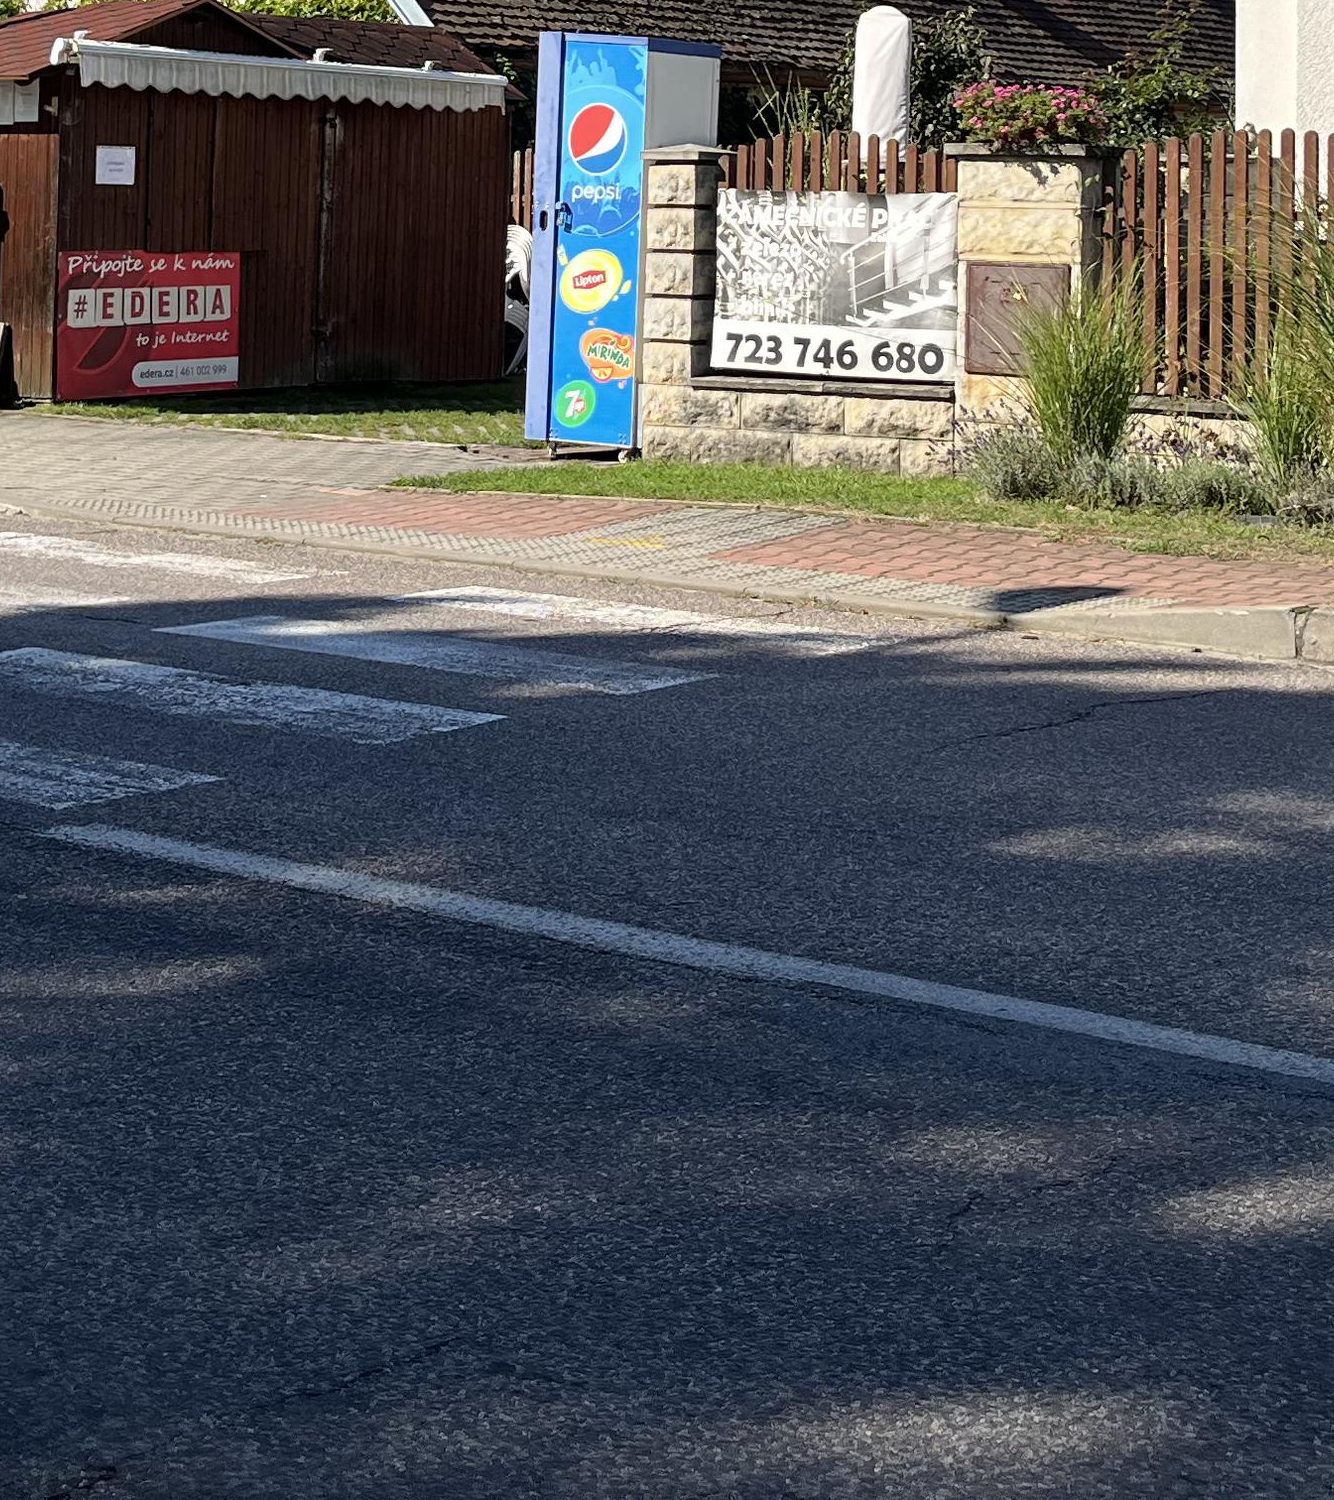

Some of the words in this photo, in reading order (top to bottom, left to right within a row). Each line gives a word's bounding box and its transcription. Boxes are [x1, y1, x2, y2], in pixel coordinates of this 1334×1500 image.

[572, 183, 621, 204] pepsi
[68, 254, 143, 277] Připojte
[148, 258, 167, 273] se
[173, 255, 186, 271] k
[192, 252, 234, 269] nám
[575, 273, 604, 287] Lipton
[74, 288, 225, 319] #EDERA
[136, 333, 149, 346] to
[153, 332, 167, 348] je
[171, 330, 230, 343] Internet
[725, 332, 783, 366] 723
[793, 337, 858, 370] 746
[871, 340, 945, 375] 680
[140, 368, 174, 379] edera.cz
[180, 366, 194, 376] 461
